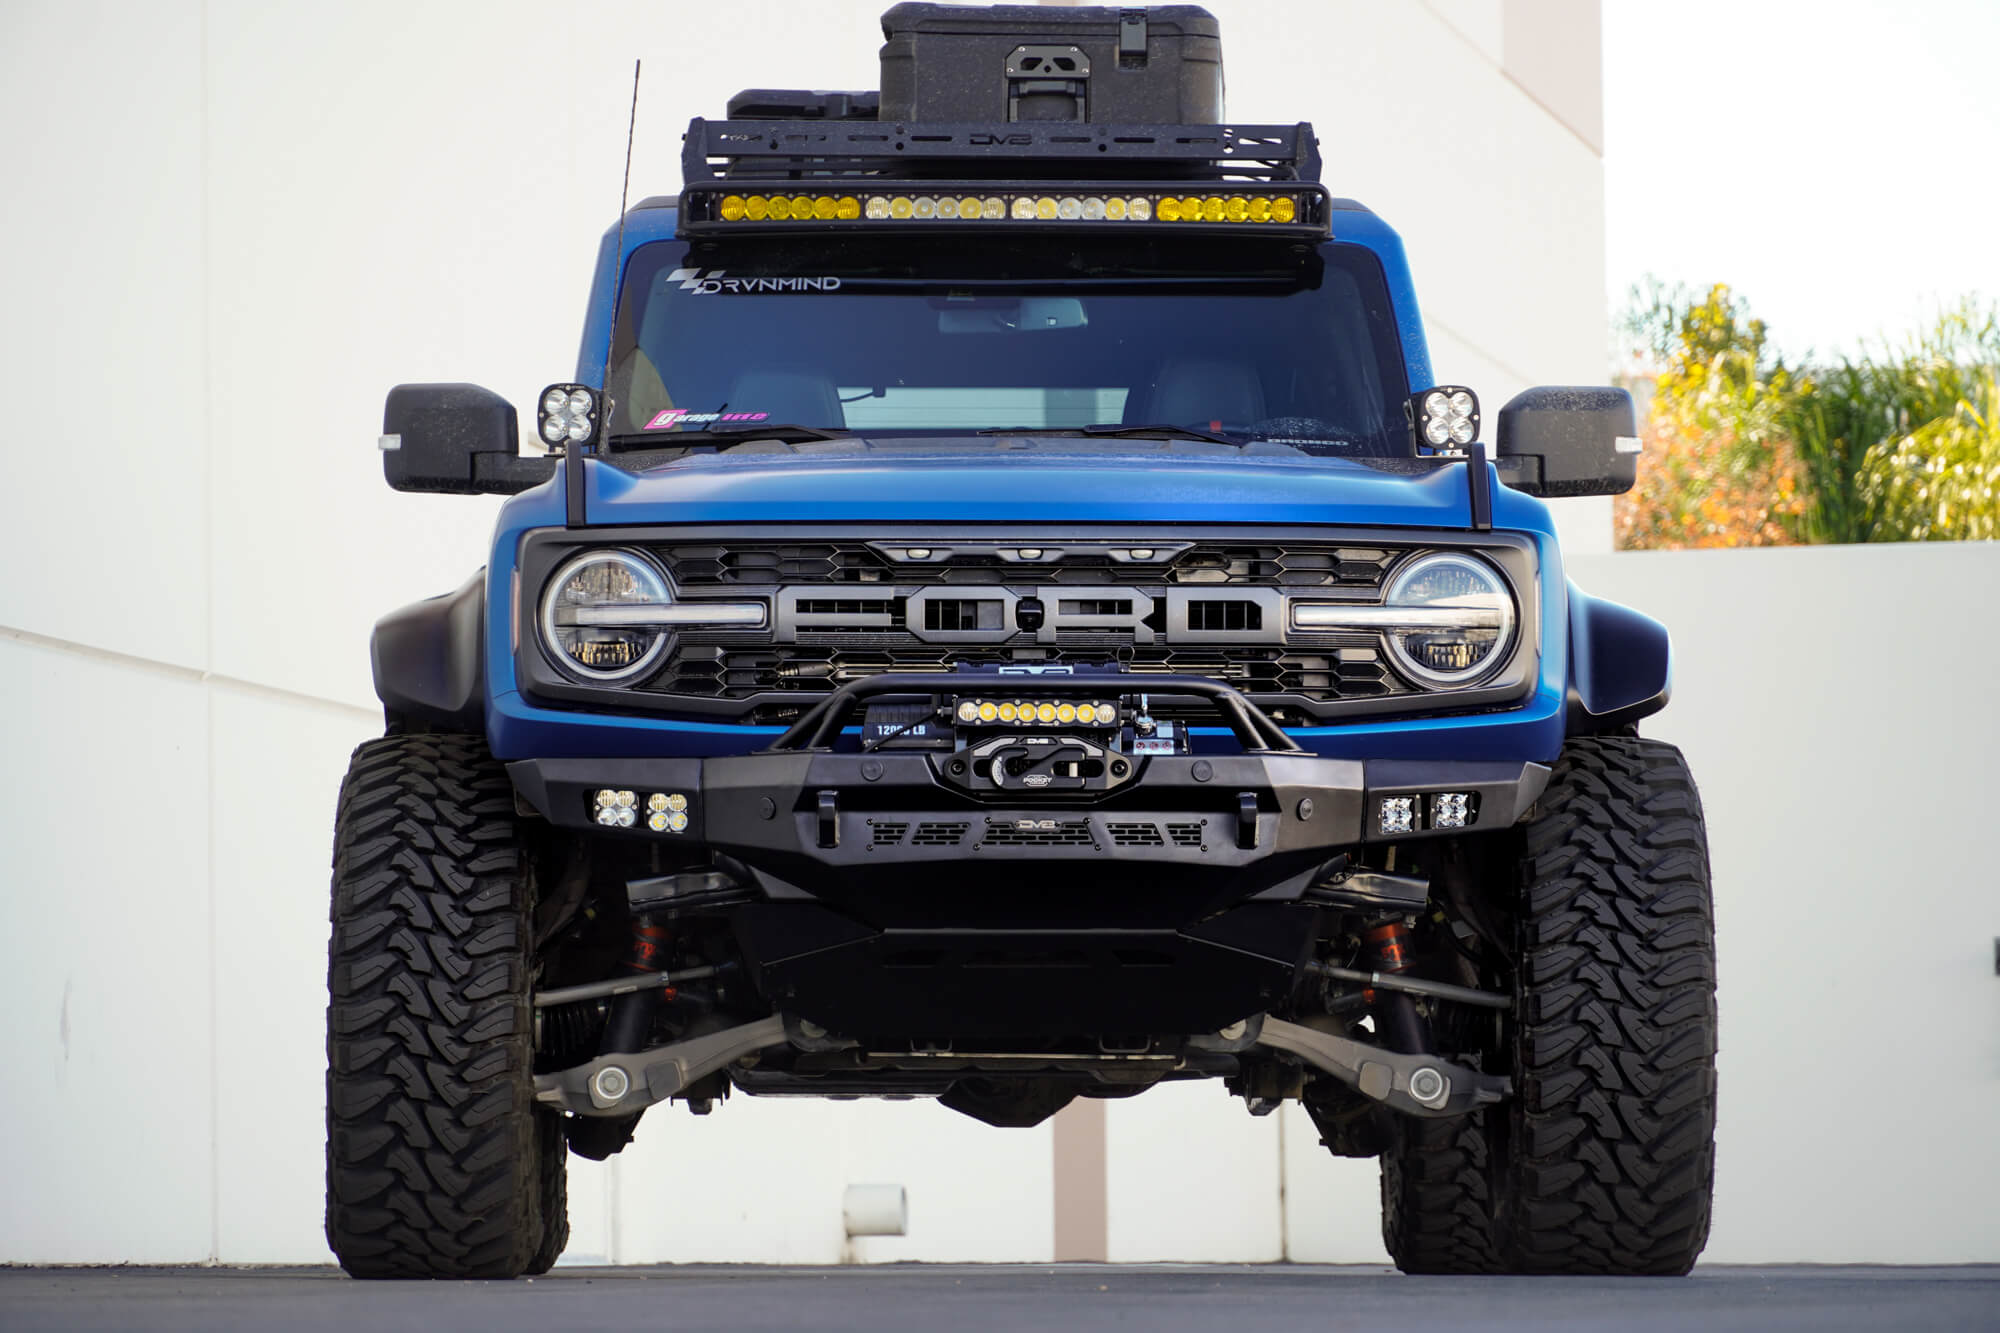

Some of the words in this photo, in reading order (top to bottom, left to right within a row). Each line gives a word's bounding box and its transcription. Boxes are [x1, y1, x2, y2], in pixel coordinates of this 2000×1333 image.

[702, 276, 841, 294] DRVNMIND
[654, 412, 721, 426] garage
[775, 584, 1286, 646] FORD
[913, 724, 926, 737] LB
[1018, 819, 1057, 829] DV8
